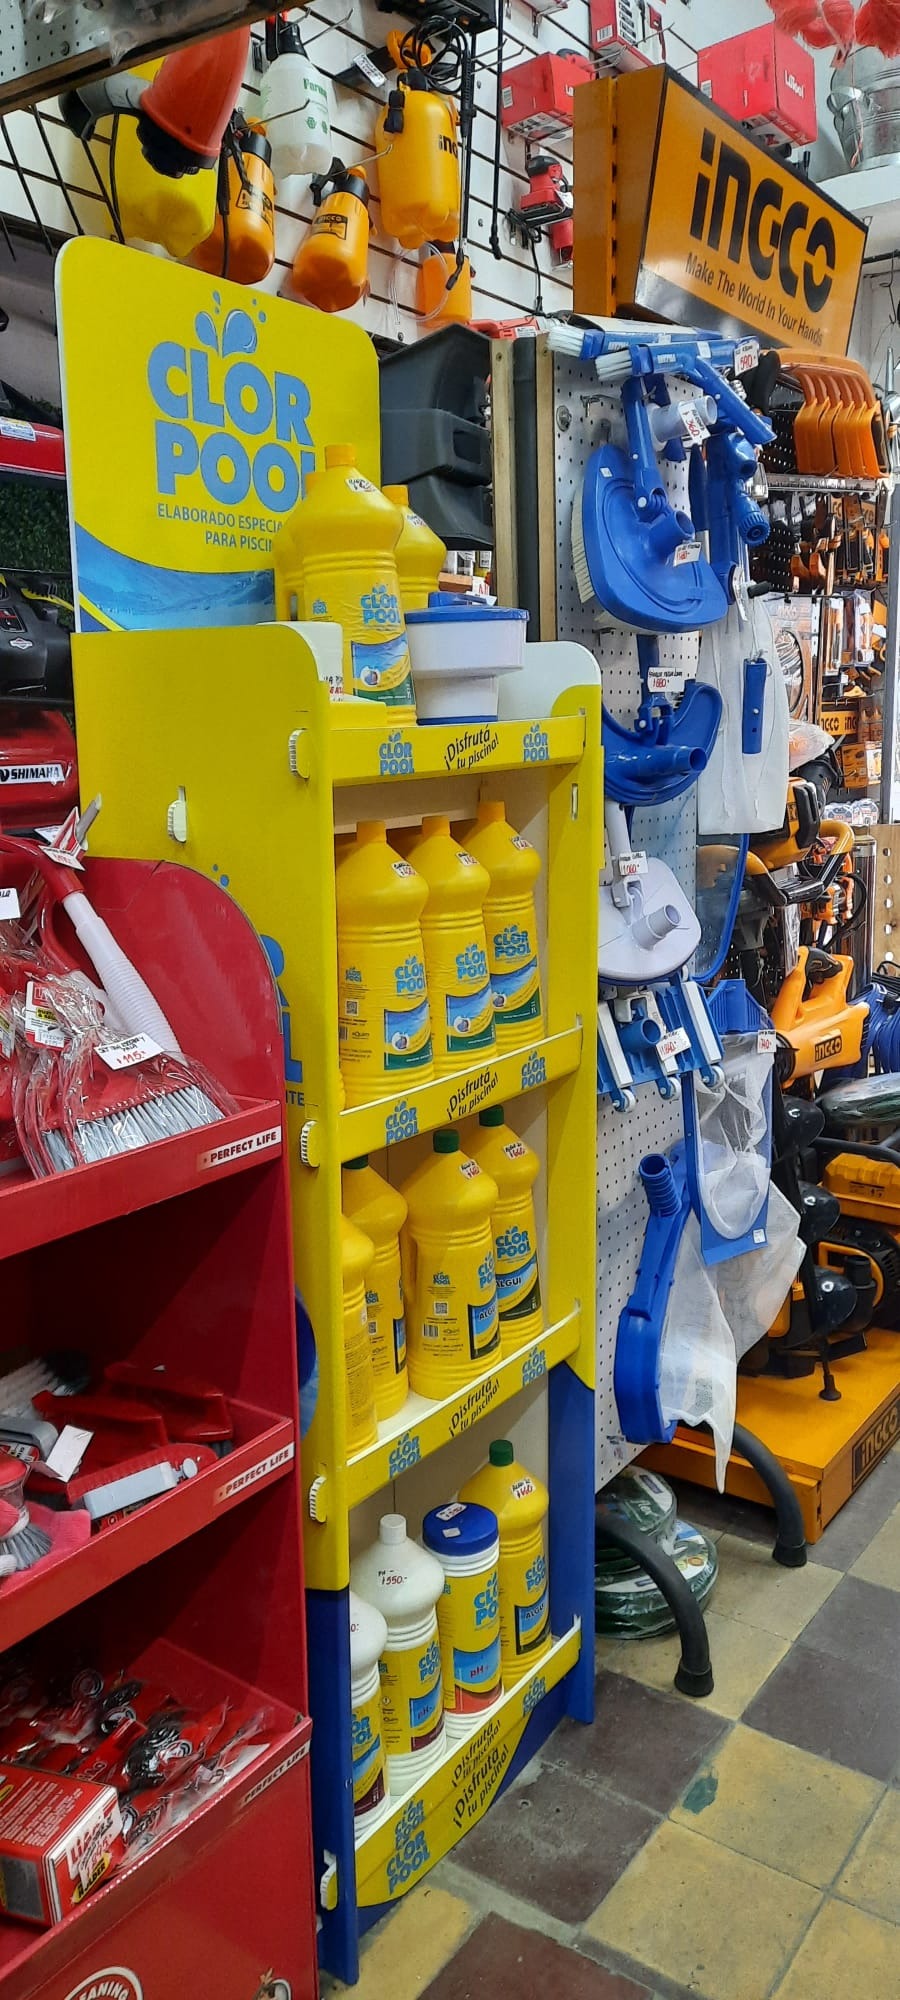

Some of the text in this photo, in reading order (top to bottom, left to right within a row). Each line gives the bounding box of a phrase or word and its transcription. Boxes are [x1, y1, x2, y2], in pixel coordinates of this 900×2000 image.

[685, 252, 823, 346] Make The World In Your Hands
[147, 341, 315, 447] CLOR
[157, 503, 236, 528] ELABORADO
[205, 530, 237, 548] PARA
[379, 742, 412, 760] CLOR
[457, 732, 500, 770] tu piscina!
[523, 733, 548, 749] CLOR
[380, 759, 414, 776] POOL
[523, 748, 550, 763] POOL
[493, 931, 528, 947] CLOR
[494, 942, 531, 958] POOL
[521, 1056, 545, 1077] CLOR
[458, 1073, 499, 1117] tu piscina!
[521, 1071, 547, 1091] POOL
[386, 1106, 417, 1131] CLOR
[210, 1131, 277, 1163] PERFECT LIFE
[386, 1121, 419, 1145] POOL
[495, 1230, 529, 1247] CLOR
[497, 1242, 530, 1259] POOL
[522, 1350, 546, 1374] CLOR
[522, 1364, 547, 1387] POOL
[459, 1379, 500, 1432] tu piscina!
[389, 1437, 420, 1465] CLOR
[389, 1445, 421, 1480] POOL
[226, 1448, 289, 1494] PERFECT LIFE
[523, 1679, 546, 1709] CLOR
[523, 1690, 547, 1718] POOL
[244, 1746, 306, 1802] PERFECT LIFE
[467, 1743, 509, 1818] tu piscina!
[395, 1801, 424, 1835] CLOR
[396, 1814, 425, 1850] POOL
[386, 1830, 425, 1878] CLOR
[389, 1847, 430, 1896] POOL
